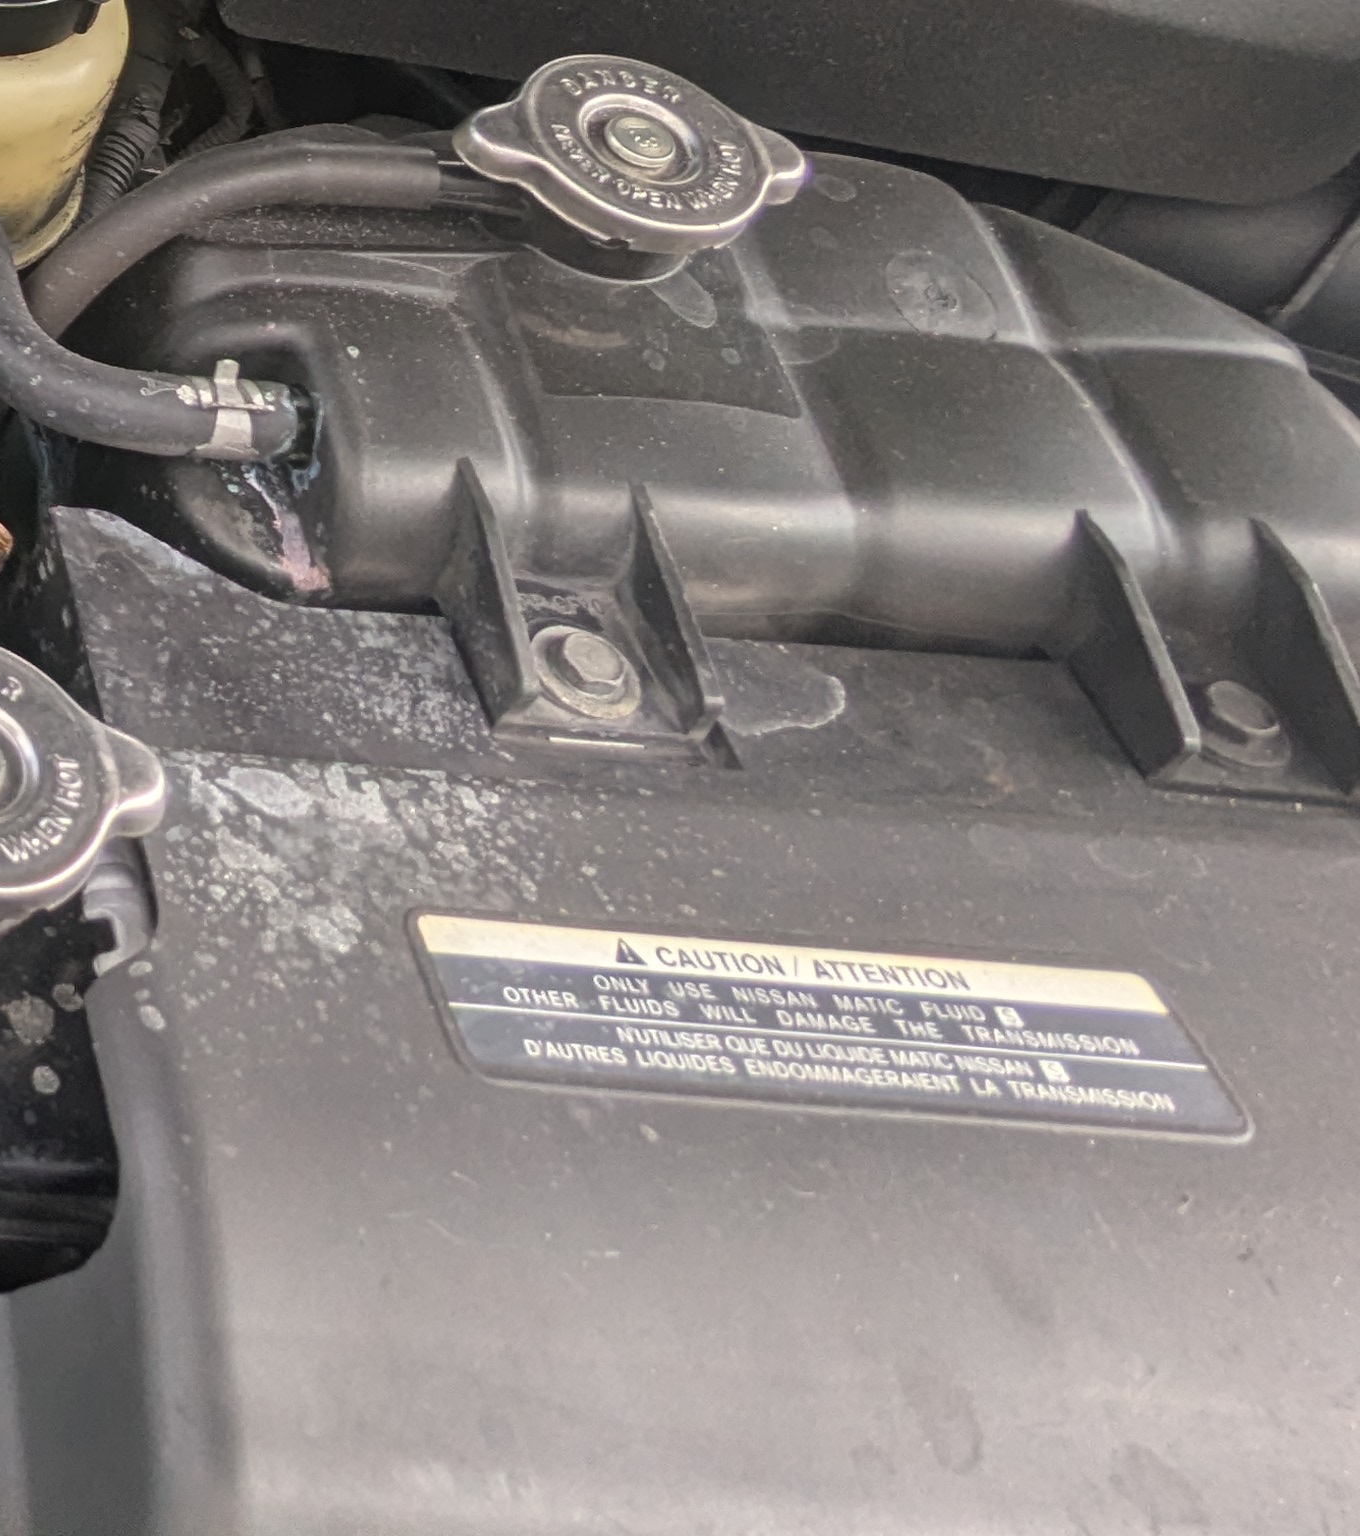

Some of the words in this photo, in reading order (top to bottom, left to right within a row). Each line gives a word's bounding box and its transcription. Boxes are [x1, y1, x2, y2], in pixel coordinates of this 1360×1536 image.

[560, 69, 682, 104] DANGER
[616, 178, 683, 210] OPEN
[0, 802, 74, 863] WHEN
[52, 753, 85, 807] HOT
[655, 945, 786, 977] CAUTION
[814, 959, 971, 991] ATTENTION
[503, 987, 579, 1009] OTHER
[600, 995, 680, 1018] FLUIDS
[700, 1004, 757, 1025] WILL
[777, 1010, 874, 1034] DAMAGE
[895, 1019, 943, 1039] THE
[962, 1025, 1140, 1056] TRANSMISSION
[593, 974, 650, 996] ONLY
[669, 982, 715, 1001] USE
[732, 985, 817, 1008] NISSAN
[832, 994, 904, 1017] MATIC
[922, 1001, 986, 1022] FLUID
[523, 1038, 626, 1065] D'AUTRES
[637, 1049, 735, 1075] LIQUIDES
[744, 1058, 961, 1095] ENDOMMAGERAIENT
[970, 1078, 1000, 1097] LA
[1007, 1081, 1176, 1114] TRANSMISSION
[726, 1034, 768, 1055] QUE
[777, 1040, 805, 1058] DU
[809, 1042, 886, 1064] LIQUIDE
[890, 1048, 953, 1070] MATIC
[956, 1055, 1034, 1078] NISSAN
